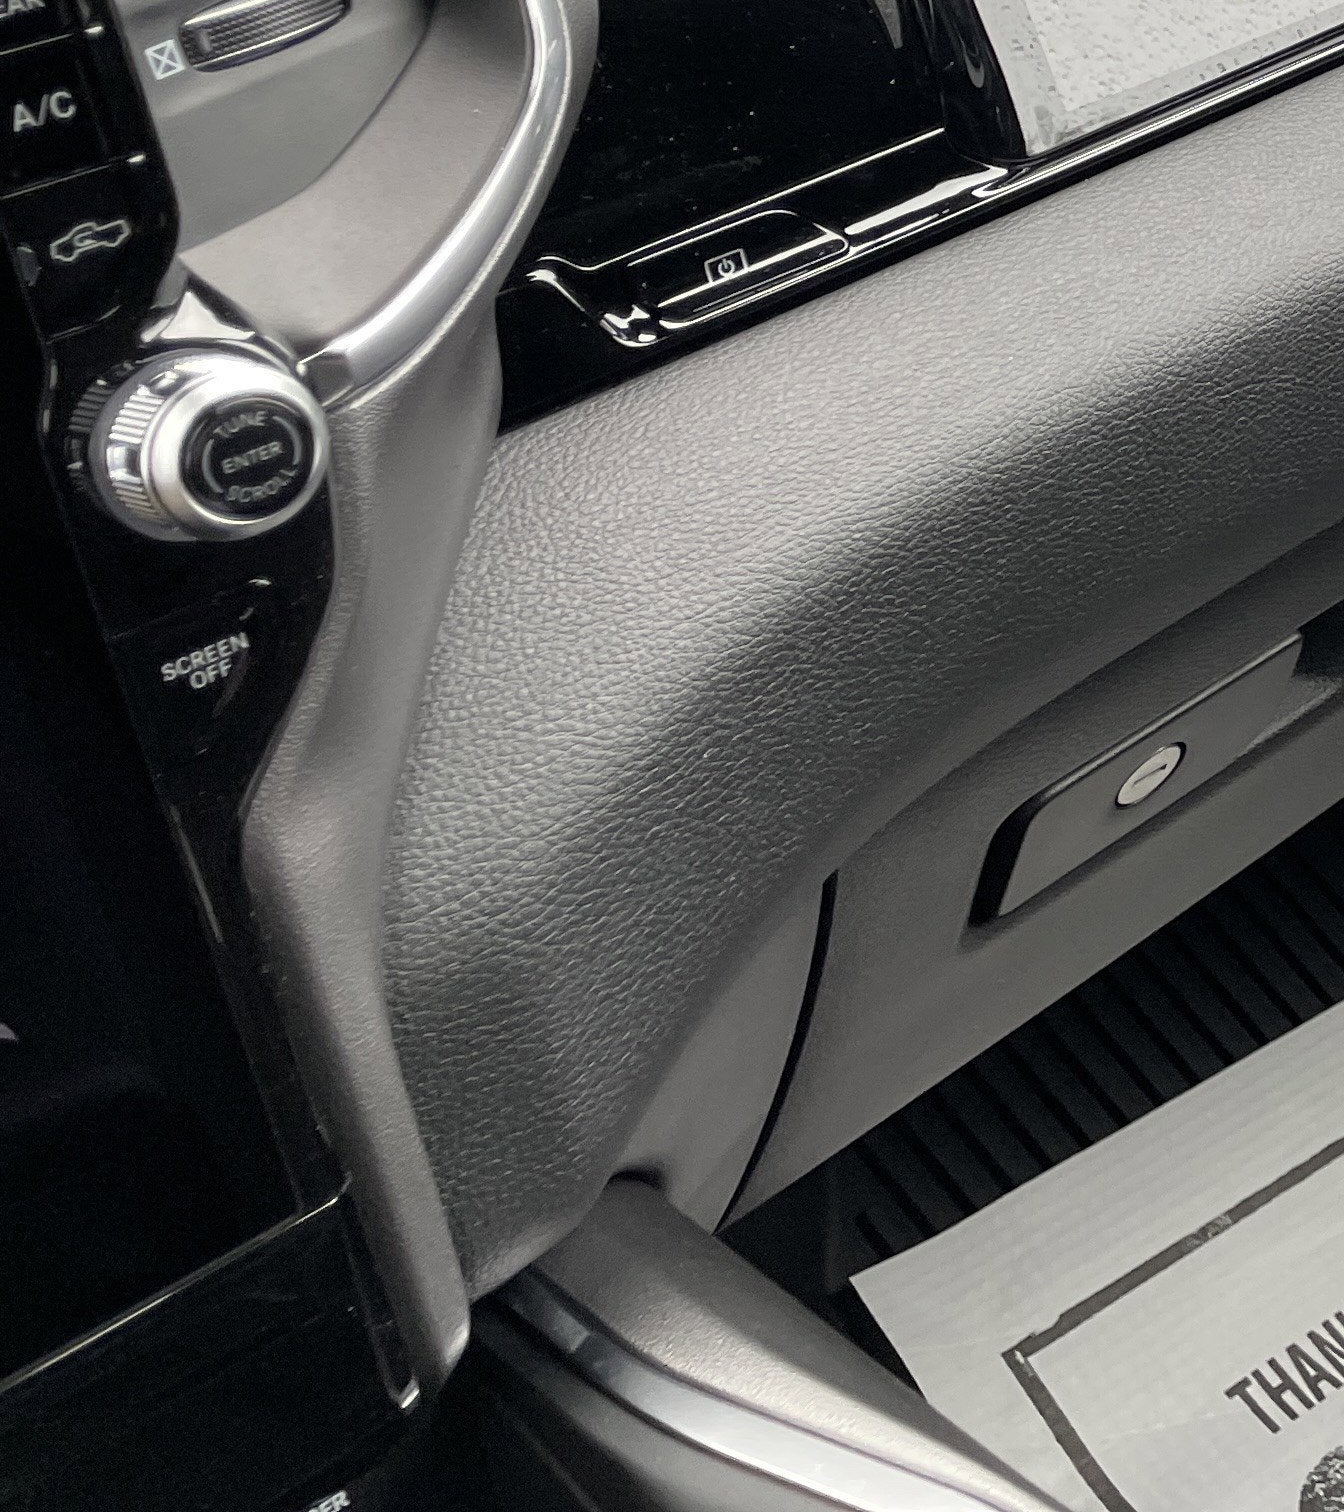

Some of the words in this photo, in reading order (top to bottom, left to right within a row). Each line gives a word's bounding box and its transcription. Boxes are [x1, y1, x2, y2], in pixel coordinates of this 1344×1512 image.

[12, 90, 77, 133] A/C
[212, 410, 268, 439] TUNE
[222, 441, 283, 475] ENTER
[227, 469, 299, 503] SCROLL
[160, 631, 250, 682] SCREEN
[189, 657, 232, 690] OFF
